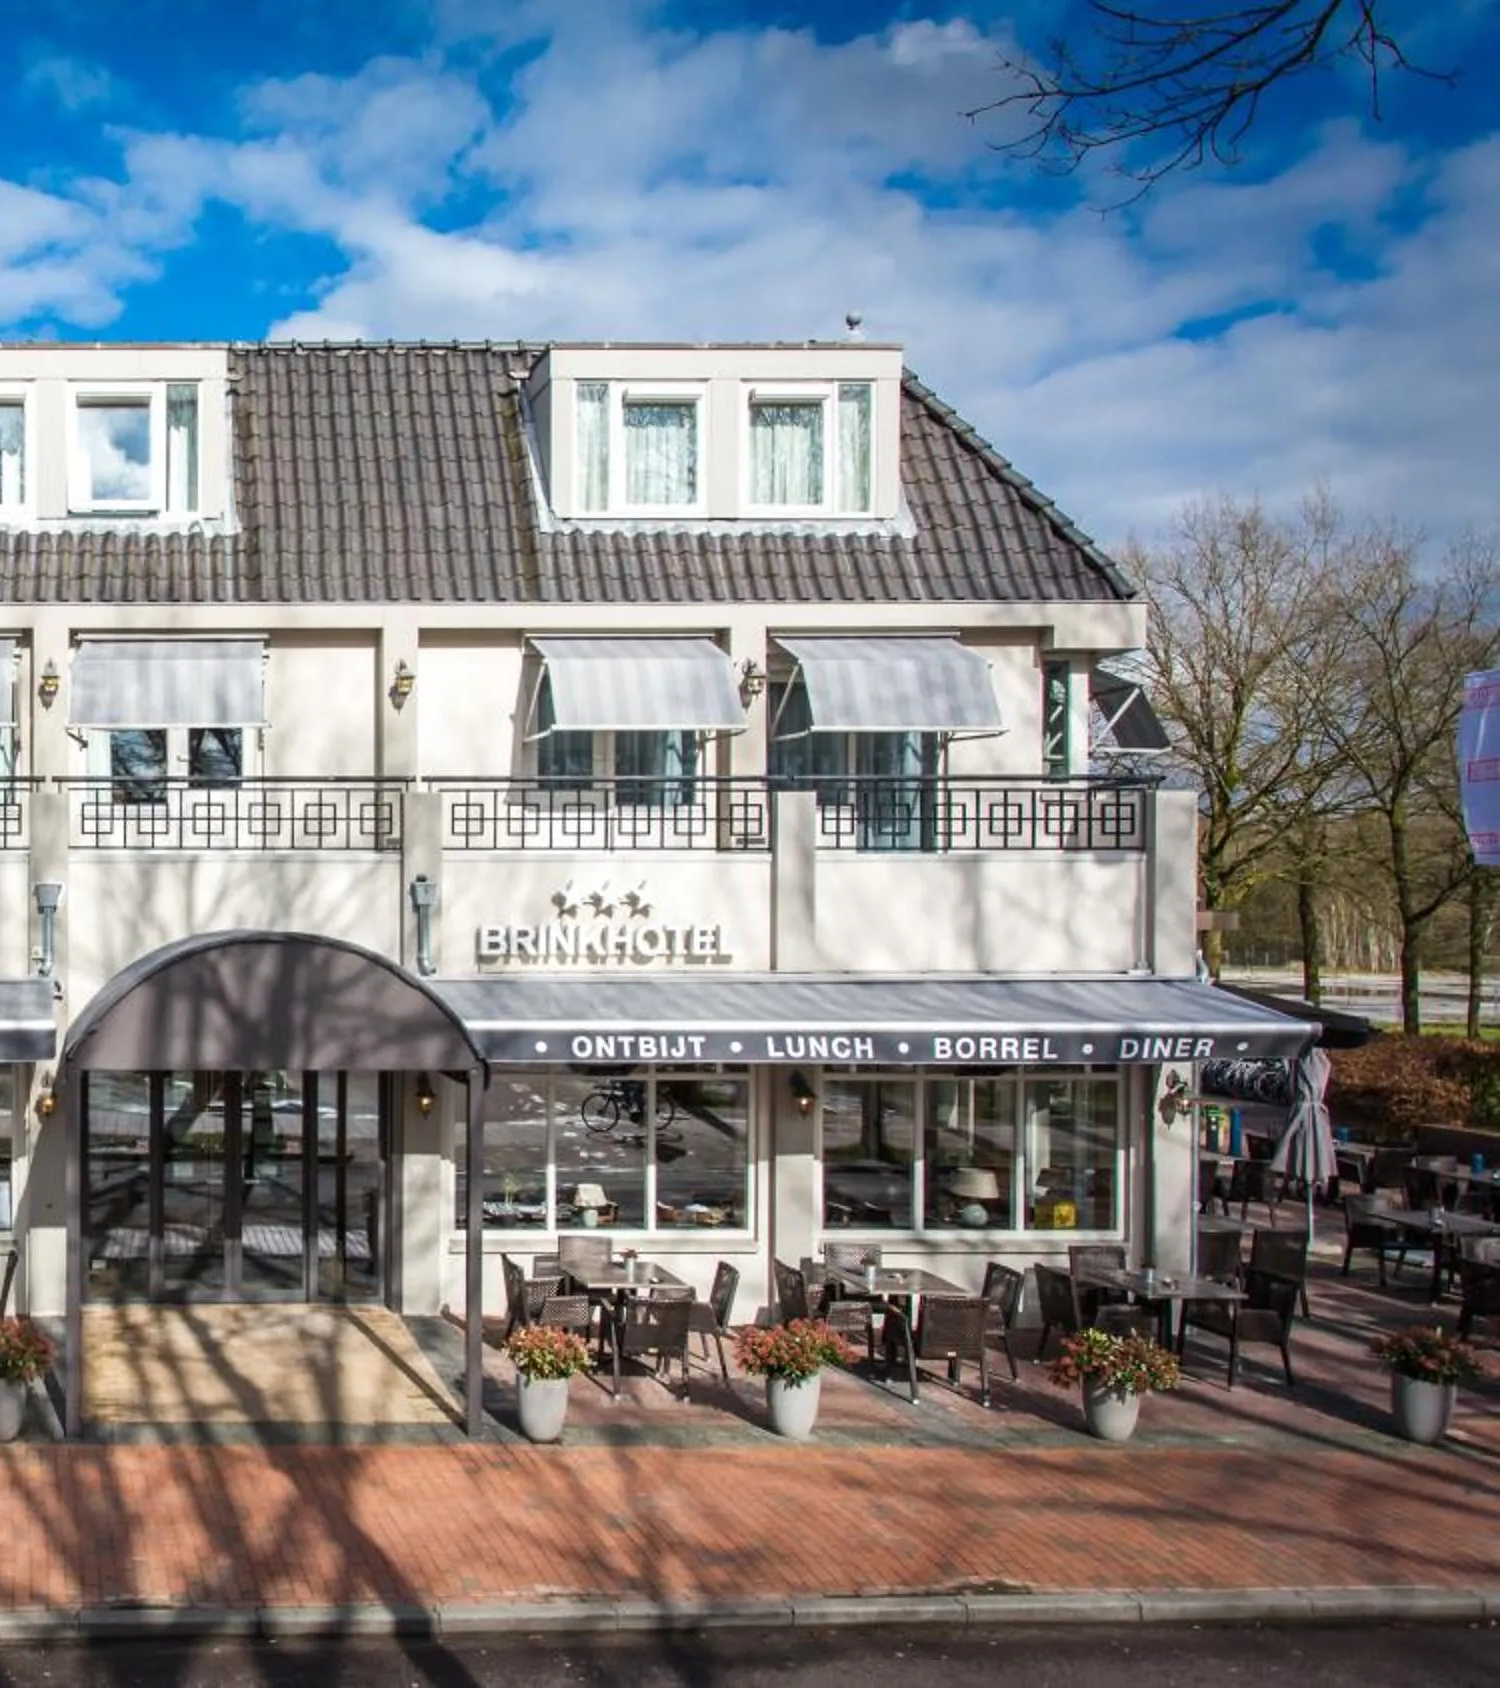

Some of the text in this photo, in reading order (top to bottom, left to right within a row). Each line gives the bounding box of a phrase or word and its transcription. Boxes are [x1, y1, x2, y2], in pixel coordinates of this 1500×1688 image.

[476, 924, 731, 958] BRINKHOTEL
[571, 1035, 1214, 1060] ONTBIJT LUNCH BORREL DINER
